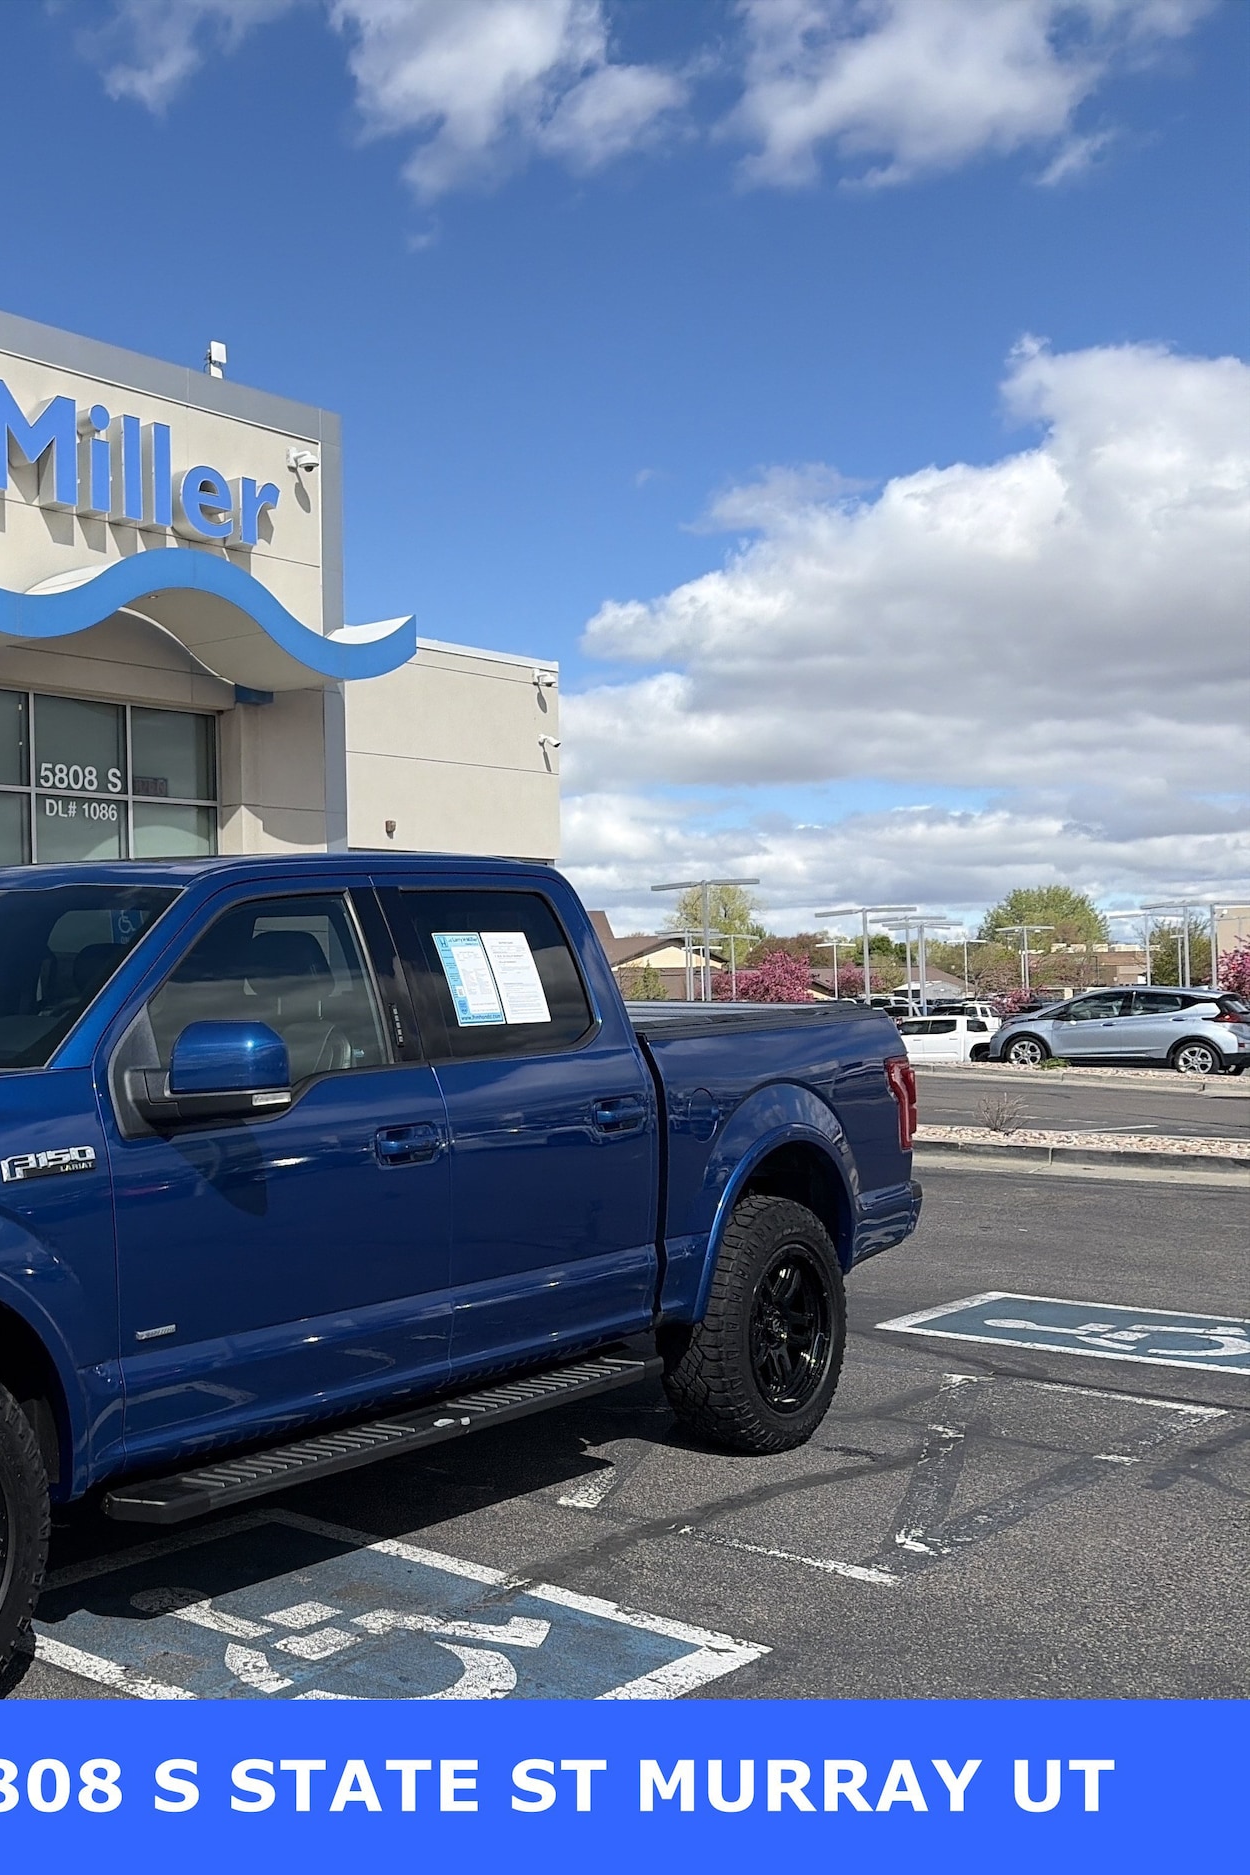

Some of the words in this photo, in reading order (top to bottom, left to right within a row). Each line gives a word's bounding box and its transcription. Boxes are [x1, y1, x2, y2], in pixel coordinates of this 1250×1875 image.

[40, 763, 98, 790] 5808
[108, 768, 122, 793] S
[45, 799, 76, 817] DL#
[82, 803, 117, 821] 1086
[60, 1161, 93, 1172] LARIAT
